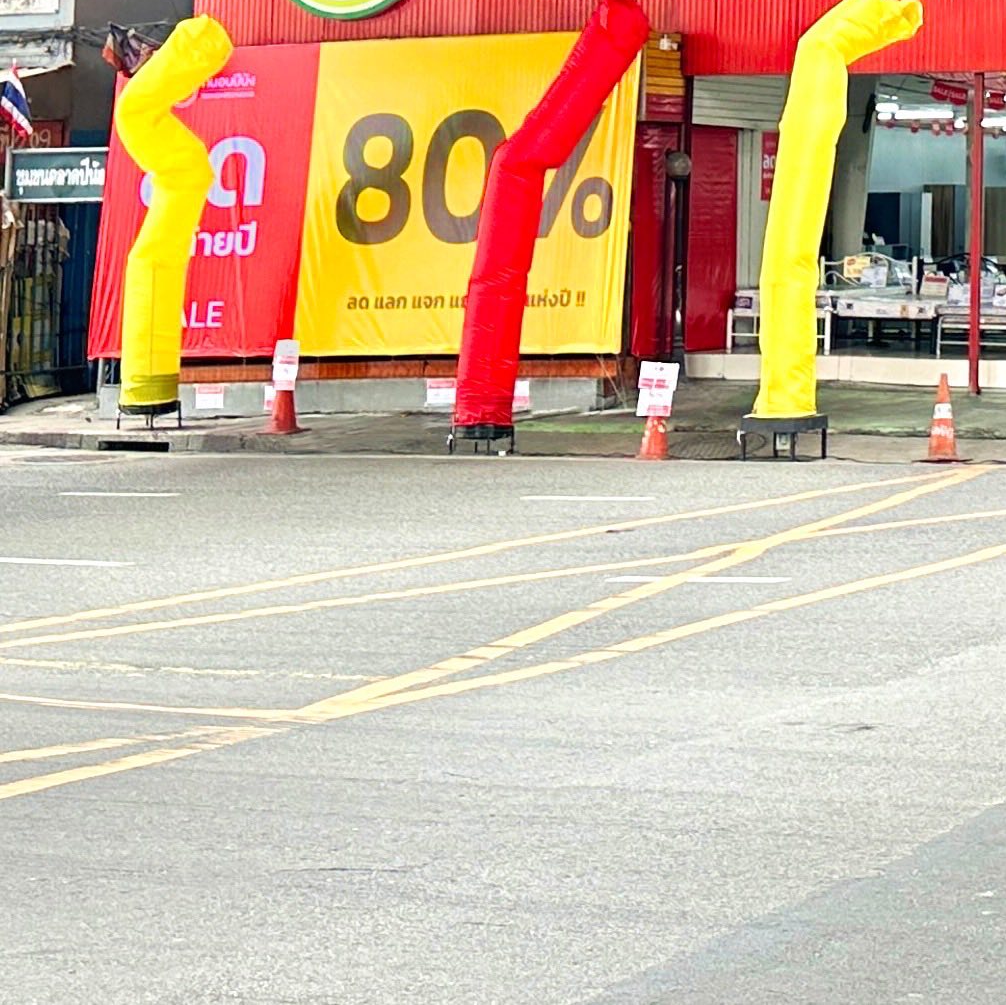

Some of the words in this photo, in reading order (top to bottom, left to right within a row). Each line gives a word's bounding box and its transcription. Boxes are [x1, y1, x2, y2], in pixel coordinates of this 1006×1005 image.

[347, 296, 370, 310] ลด
[374, 295, 407, 310] แลก
[411, 295, 445, 309] แจก
